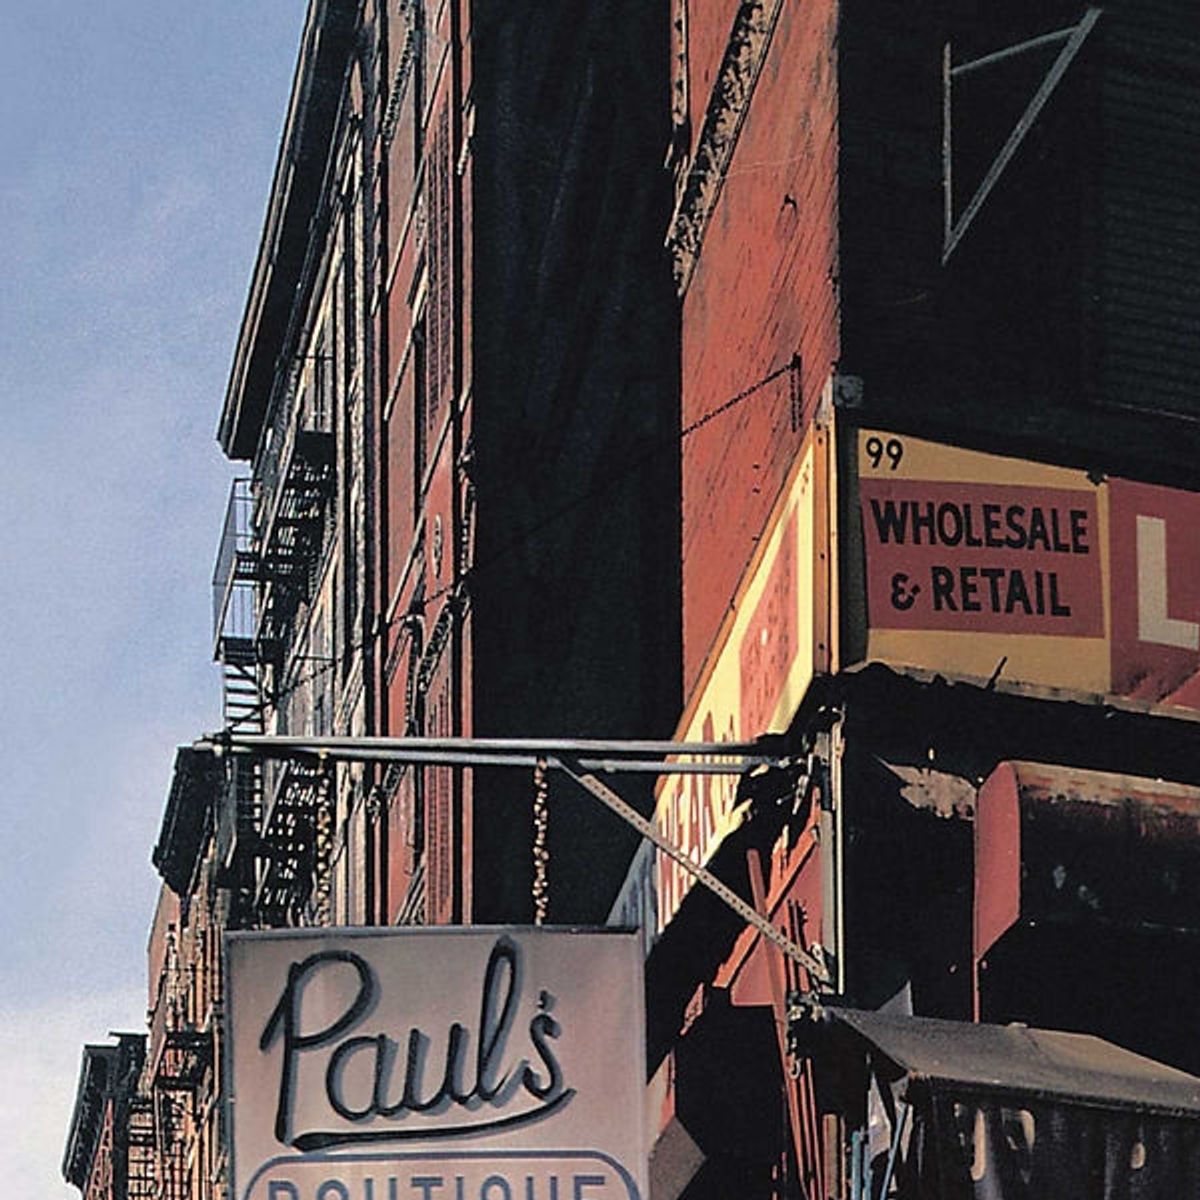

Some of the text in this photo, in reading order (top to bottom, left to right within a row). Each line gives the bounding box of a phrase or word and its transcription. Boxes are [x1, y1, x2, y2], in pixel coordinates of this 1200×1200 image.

[865, 436, 904, 470] 99
[871, 499, 1089, 554] WHOLESALE
[933, 565, 1072, 617] RETAIL
[260, 935, 577, 1151] Paul's
